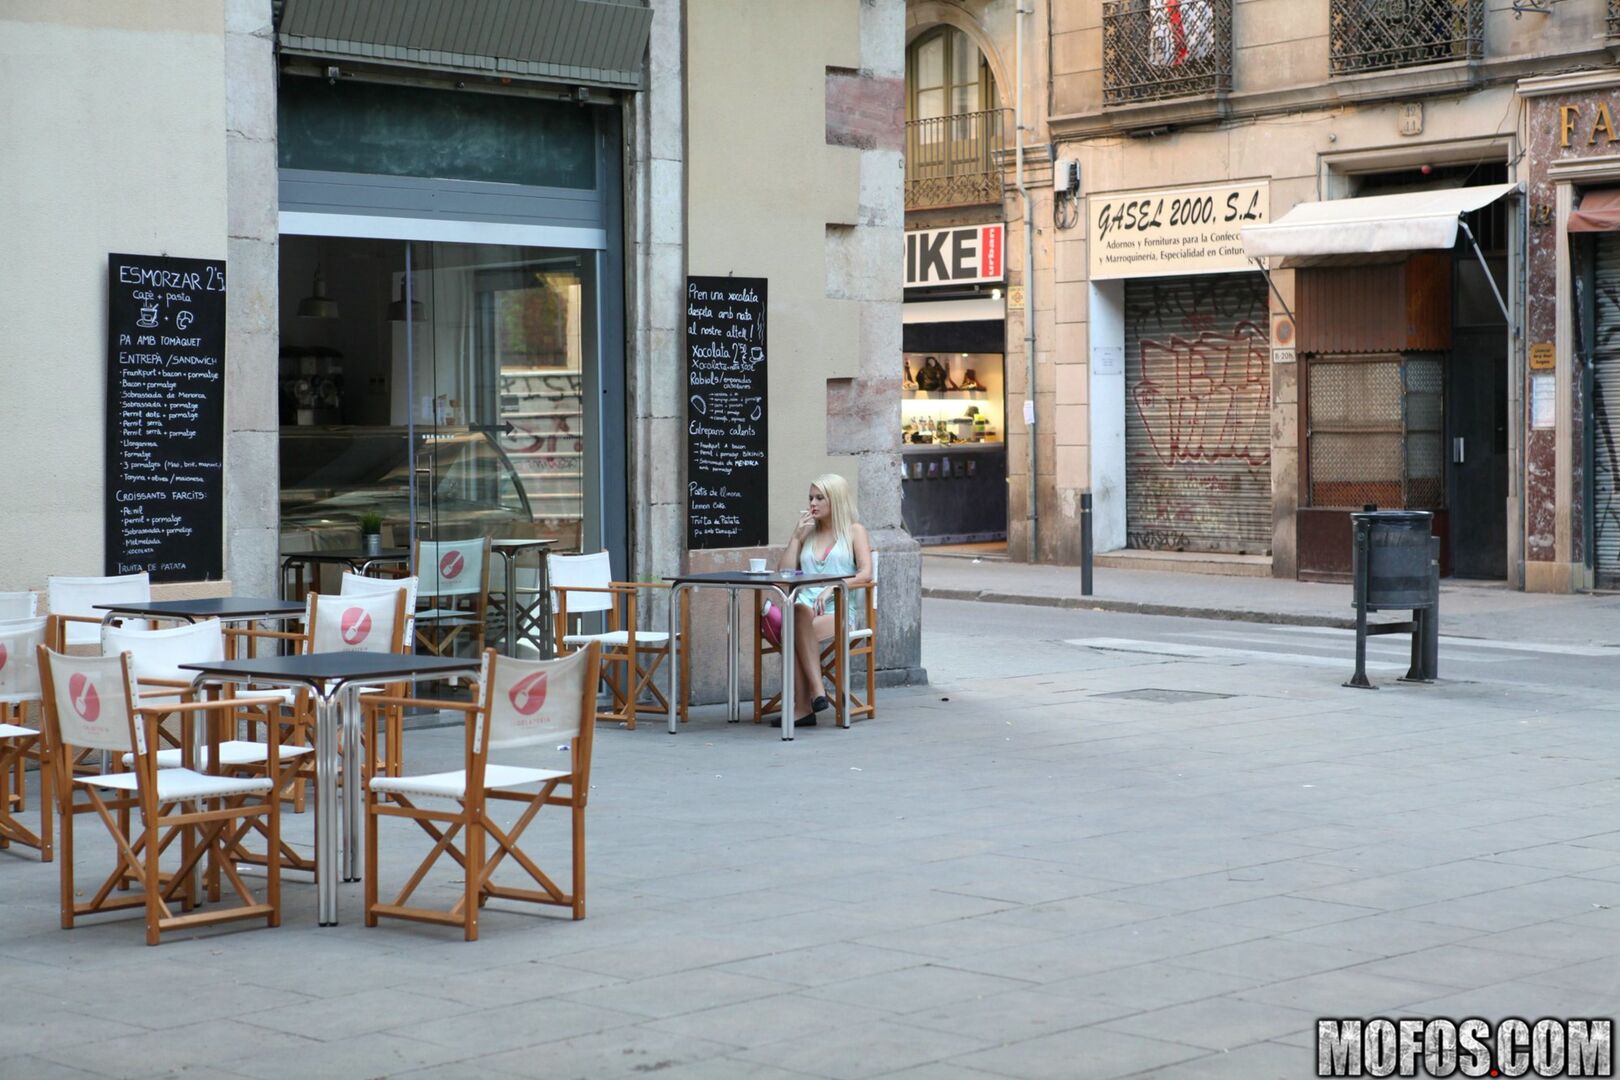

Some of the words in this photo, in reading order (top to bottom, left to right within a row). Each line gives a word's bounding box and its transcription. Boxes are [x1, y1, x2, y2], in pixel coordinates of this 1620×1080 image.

[1098, 198, 1164, 241] GASEL
[1224, 190, 1263, 222] S.L.
[1106, 240, 1135, 249] Adornos
[1137, 241, 1141, 249] y
[1144, 237, 1180, 247] Fornituras
[1182, 235, 1198, 245] para
[1201, 233, 1208, 242] la
[904, 228, 978, 283] IKE
[1099, 257, 1103, 265] y
[1160, 248, 1205, 261] Especialidad
[1207, 249, 1217, 257] en
[120, 266, 202, 290] ESMORZAR
[166, 292, 192, 308] pasta
[688, 283, 708, 300] Pren
[710, 291, 724, 301] una
[728, 288, 759, 303] xocolata
[718, 305, 734, 319] amb
[736, 307, 752, 321] nata
[687, 321, 697, 335] al
[700, 325, 722, 336] nostre
[120, 334, 131, 345] PA
[137, 335, 156, 345] AMB
[161, 336, 201, 347] TOMÀQUET
[691, 341, 731, 358] Xocolata
[729, 423, 756, 436] calents
[116, 490, 167, 502] CROISSANTS
